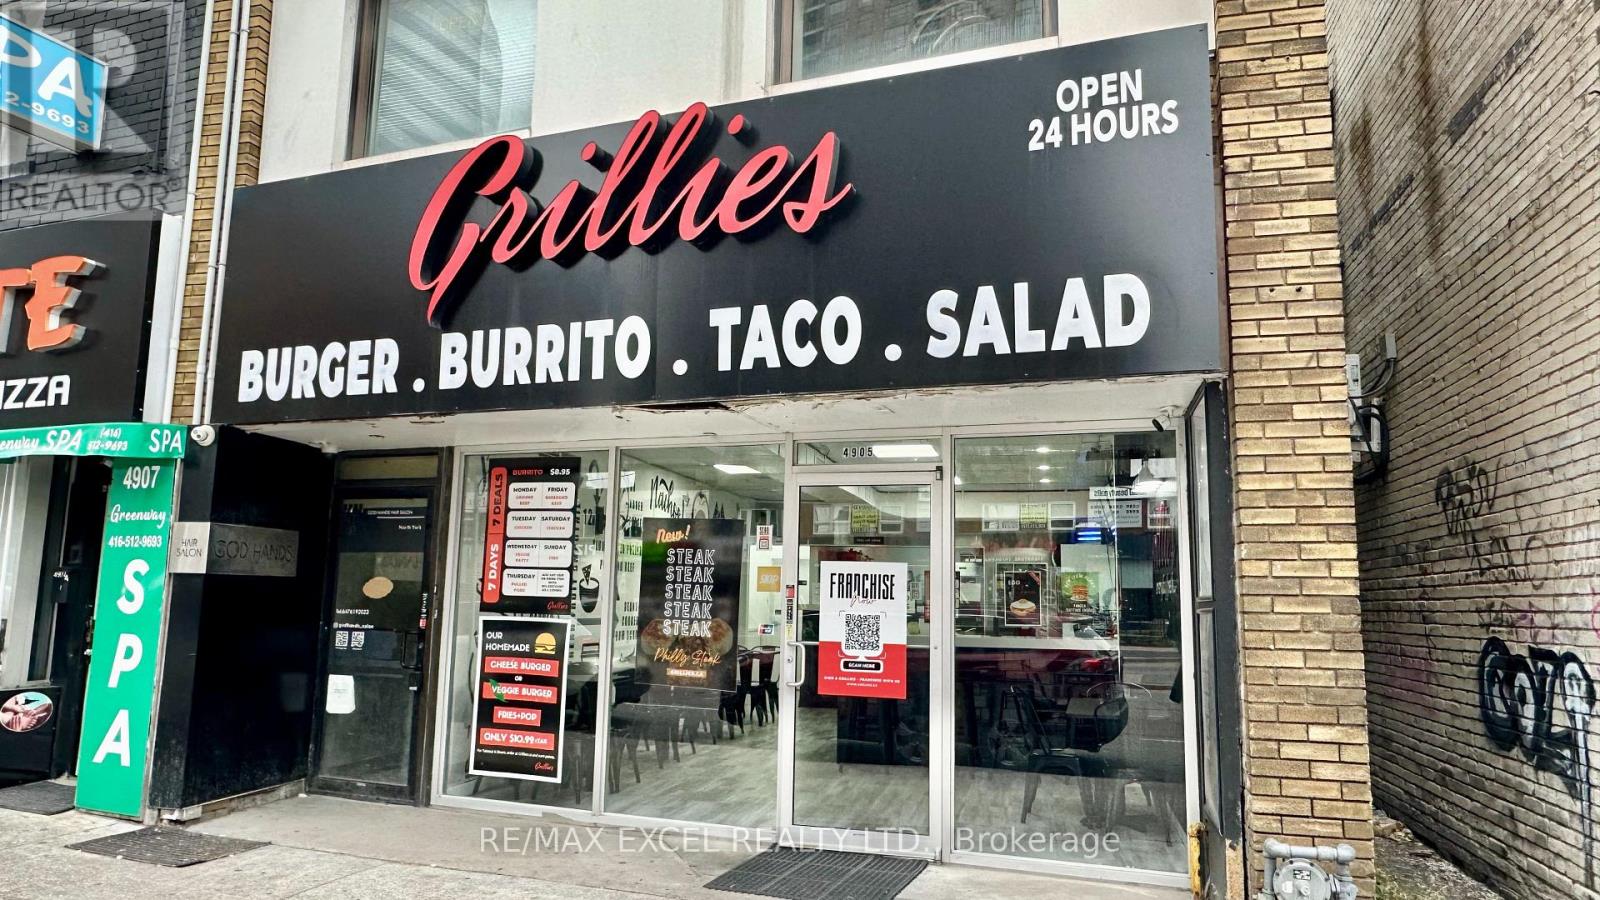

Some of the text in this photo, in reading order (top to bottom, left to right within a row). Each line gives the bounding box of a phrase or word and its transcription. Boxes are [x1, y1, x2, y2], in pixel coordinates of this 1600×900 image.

[1056, 68, 1143, 112] OPEN
[1028, 99, 1179, 152] 24 HOURS
[407, 101, 857, 328] Grillies
[237, 272, 1151, 403] BURGER BURRITO TACO SALAD
[46, 429, 83, 451] SPA
[148, 428, 182, 453] SPA
[843, 447, 873, 458] 4905
[123, 465, 161, 489] 4907
[550, 468, 571, 476] $8.95
[493, 473, 503, 516] DEALS
[110, 504, 166, 529] Greenway
[108, 535, 162, 548] 416-512-9693
[181, 538, 198, 547] HAIR
[656, 524, 691, 544] New!
[176, 548, 202, 558] SALON
[214, 540, 293, 562] GOD HANDS
[666, 548, 716, 566] STEAK
[488, 543, 499, 591] 7 DAYS
[665, 565, 715, 584] STEAK
[664, 583, 714, 602] STEAK
[829, 572, 895, 600] FRANCHISE
[663, 601, 713, 619] STEAK
[486, 631, 503, 639] OUR
[662, 619, 712, 638] STEAK
[485, 643, 530, 652] HOMEMADE
[490, 660, 552, 672] CHEESE BURGER
[653, 647, 721, 668] Philly Steak
[492, 685, 553, 698] VEGGIE BURGER
[497, 710, 537, 720] FRIES+POP
[483, 732, 508, 741] ONLY
